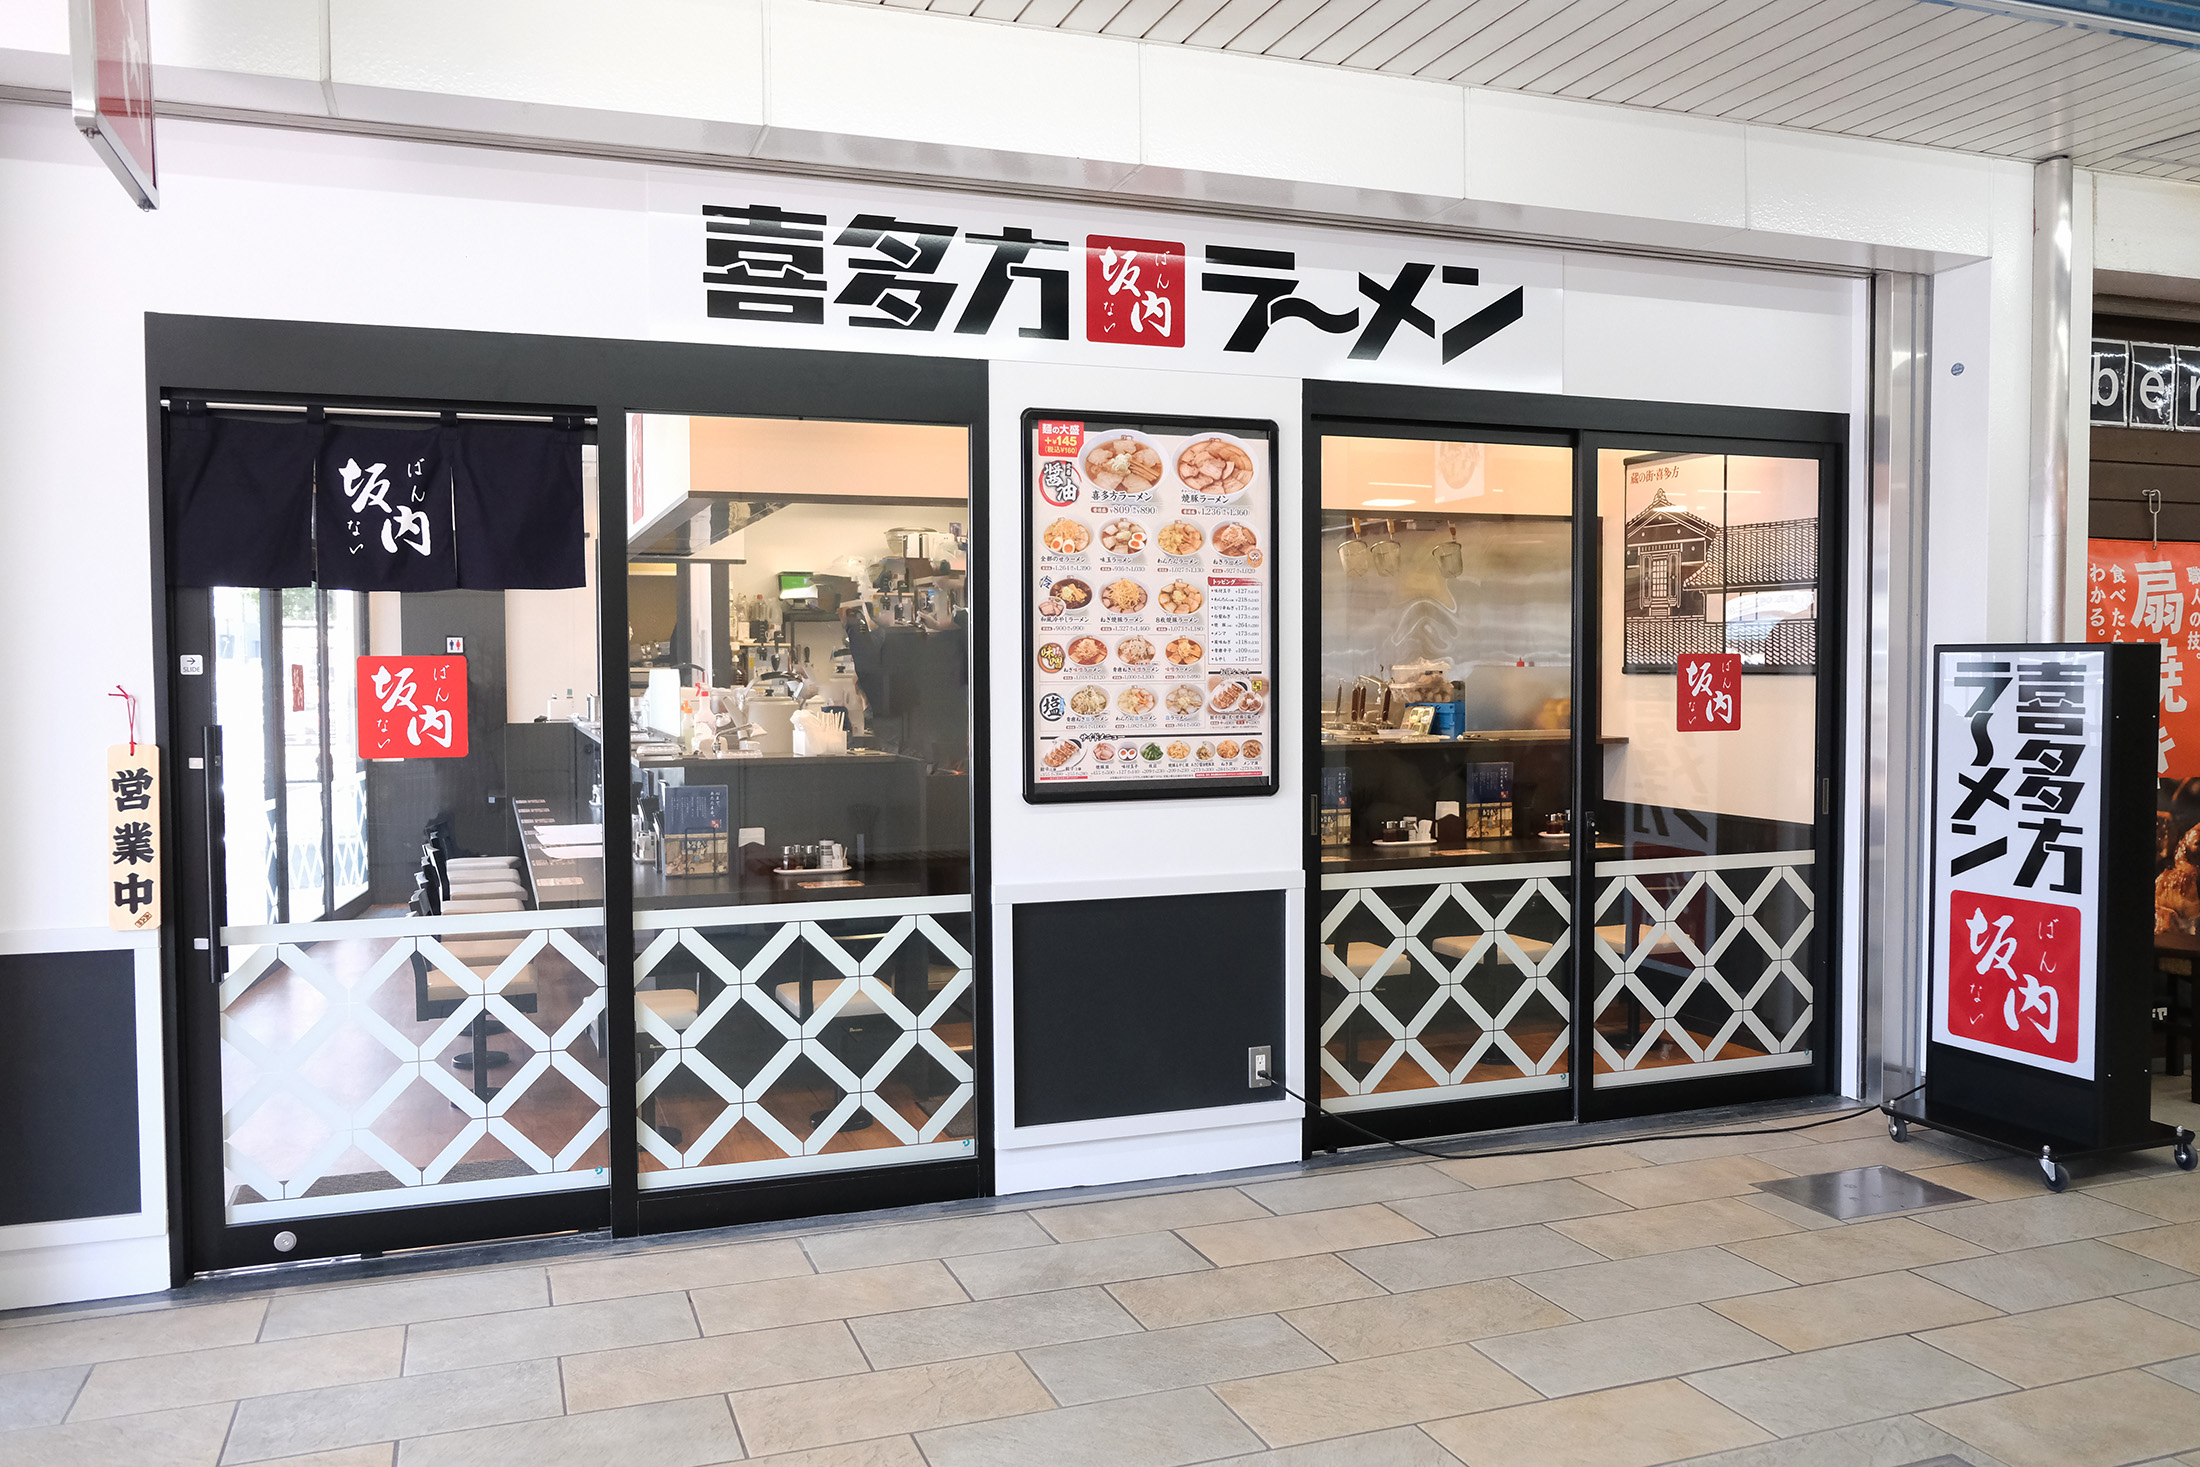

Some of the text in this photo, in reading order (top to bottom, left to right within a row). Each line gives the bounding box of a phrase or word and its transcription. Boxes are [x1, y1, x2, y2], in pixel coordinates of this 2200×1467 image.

[702, 204, 1069, 340] 喜多方
[1155, 251, 1170, 289] ばん
[1099, 246, 1171, 337] 坂内
[1103, 302, 1116, 332] ない
[1042, 423, 1080, 435] 麺の大盛
[408, 458, 425, 502] ばん
[1091, 490, 1153, 502] 喜多方ラーメン
[1181, 494, 1229, 503] 焼豚ラーメン
[338, 458, 431, 556] 坂内
[347, 520, 364, 554] ない
[2089, 563, 2106, 636] わかる。
[433, 665, 450, 702] ばん
[1685, 660, 1733, 724] 坂内
[1722, 660, 1732, 688] ばん
[371, 665, 452, 748] 坂内
[1043, 696, 1062, 717] 塩
[1688, 701, 1696, 724] ない
[377, 719, 391, 749] ない
[2013, 662, 2086, 894] 喜多方
[111, 767, 154, 914] 営業中
[2038, 918, 2059, 973] ばん
[1965, 907, 2059, 1043] 坂内
[1969, 983, 1984, 1025] ない
